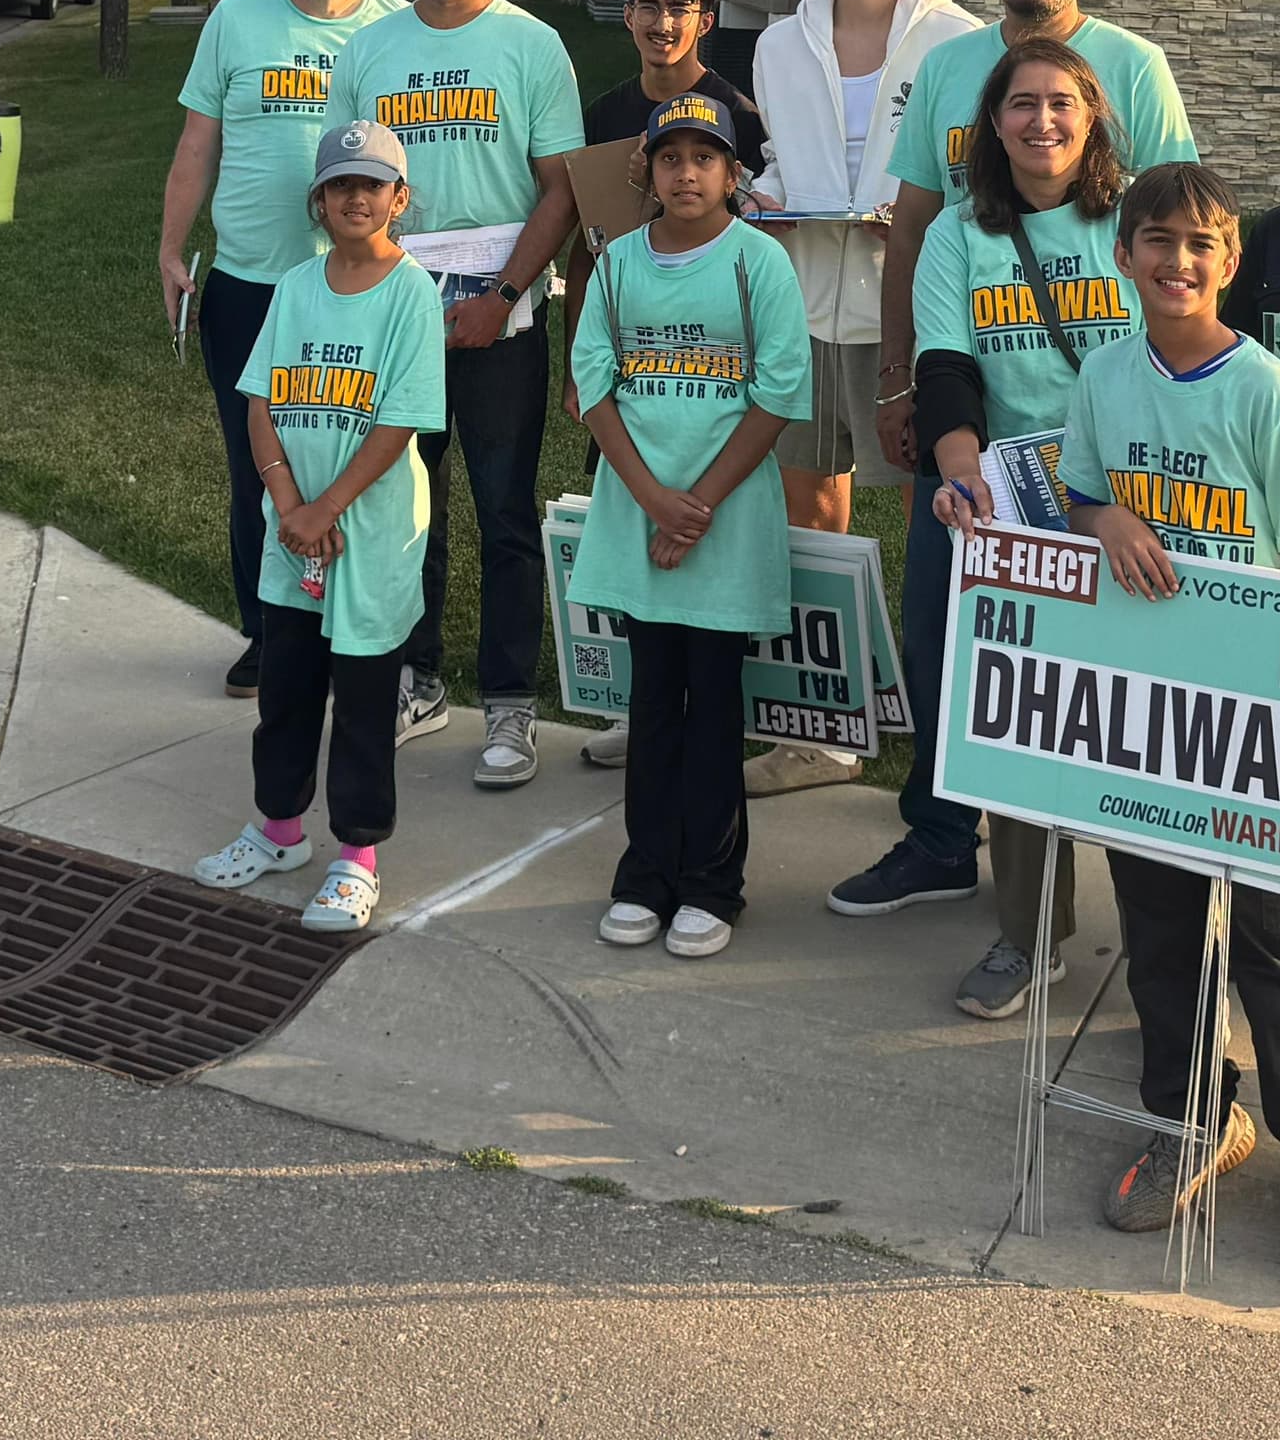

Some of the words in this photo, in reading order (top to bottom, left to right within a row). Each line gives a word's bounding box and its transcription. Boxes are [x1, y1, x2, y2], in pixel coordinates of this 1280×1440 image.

[262, 67, 334, 101] DHAL
[407, 69, 470, 89] RE-ELECT
[375, 87, 500, 128] DHALIWAL
[657, 105, 719, 128] DHALIWAL
[397, 128, 436, 146] RKING
[442, 127, 467, 141] FOR
[474, 127, 499, 143] YOU
[1012, 254, 1082, 282] RELECT
[972, 276, 1130, 330] DHAWAL
[301, 342, 364, 365] RE-ELECT
[977, 332, 1057, 355] WORKING
[1068, 330, 1088, 349] OR
[621, 344, 745, 382] ALIWAL
[675, 381, 706, 399] FOR
[1128, 441, 1208, 479] RE-EECT
[1105, 469, 1255, 538] HALIWAL
[560, 542, 573, 563] 5
[964, 534, 1097, 596] RE-ELECT
[1216, 543, 1255, 565] YOU
[973, 596, 1036, 647] RAJ
[798, 670, 851, 705] RAJ
[756, 700, 870, 747] RE-ELECT
[1098, 794, 1209, 836] COUNCILLOR
